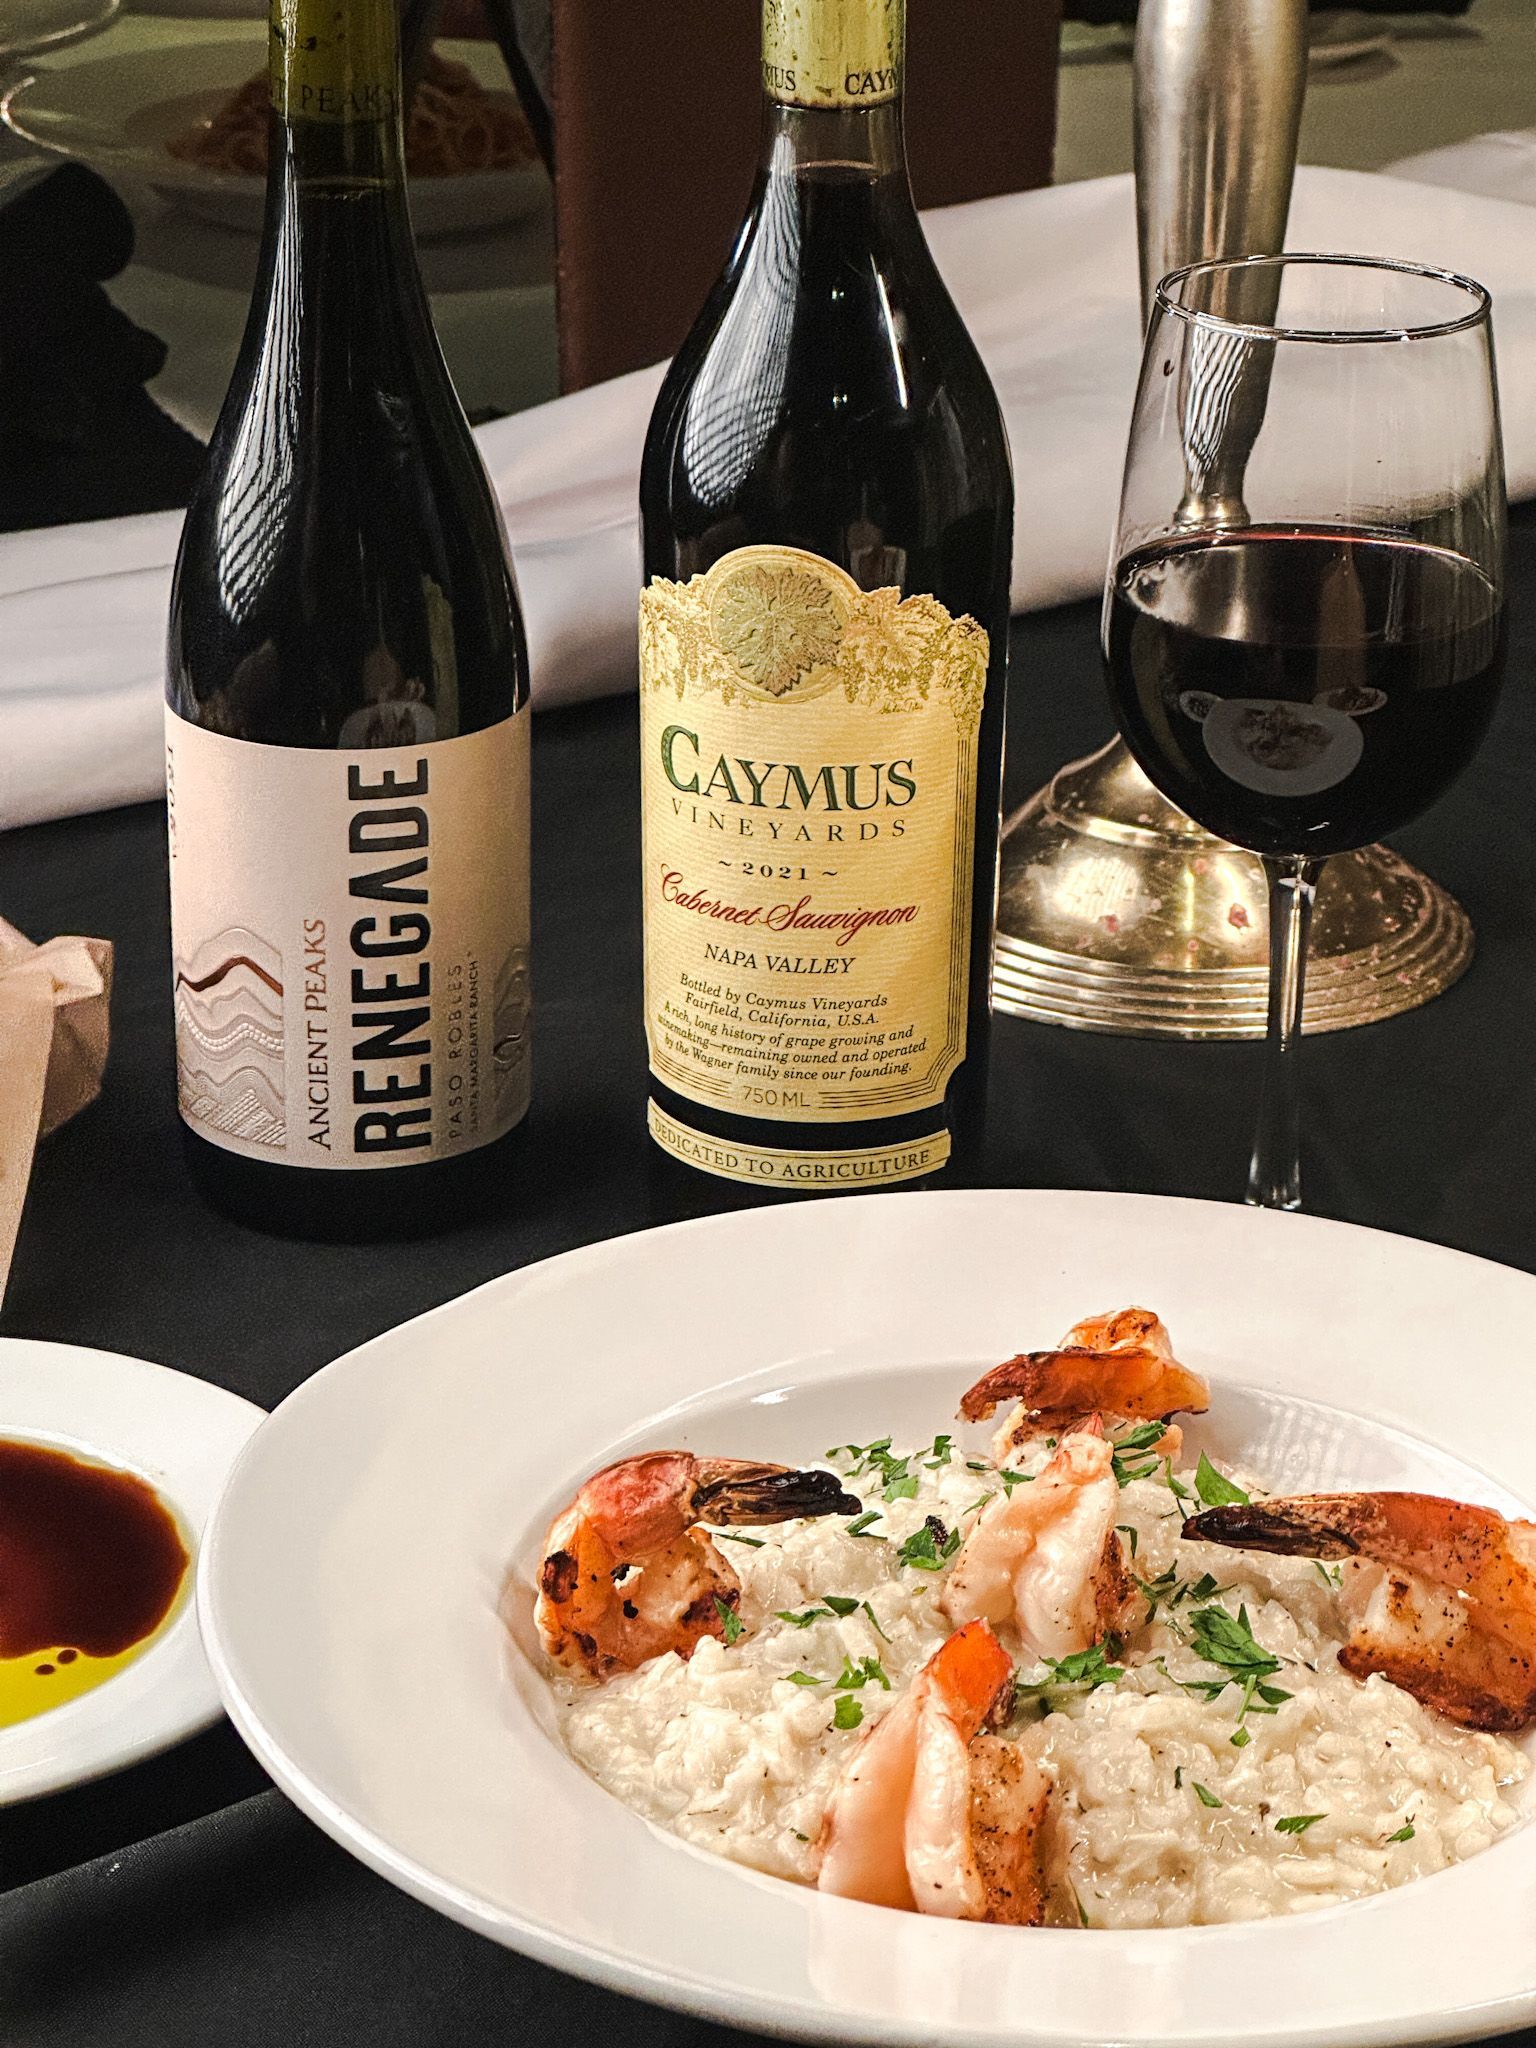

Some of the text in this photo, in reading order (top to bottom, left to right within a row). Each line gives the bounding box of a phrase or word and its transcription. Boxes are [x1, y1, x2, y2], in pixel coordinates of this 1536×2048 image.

[660, 724, 917, 812] CAYMUS
[671, 798, 906, 842] VINEYARDS
[660, 863, 921, 947] Cabernet Sauvignon
[347, 757, 432, 1154] RENEGADE
[704, 943, 857, 975] NAPA VALLEY
[680, 972, 888, 1012] Bottled by Caymus Vineyards
[685, 991, 880, 1030] Fairfield, California, U.S.A.
[297, 918, 332, 1151] ANCIENT PEAKS
[664, 1000, 671, 1013] A
[694, 1015, 718, 1036] long
[721, 1023, 766, 1046] history
[769, 1033, 785, 1047] of
[785, 1036, 826, 1050] grape
[828, 1031, 885, 1050] growing
[888, 1024, 915, 1042] and
[447, 964, 463, 1139] PASO ROBLES
[664, 1032, 912, 1082] by the Wagner family since our founding.
[792, 1051, 838, 1064] owned
[841, 1048, 870, 1062] and
[872, 1037, 927, 1061] operated
[742, 1085, 811, 1108] 750 ML
[653, 1117, 930, 1179] DEDICATED TO AGRICULTURE
